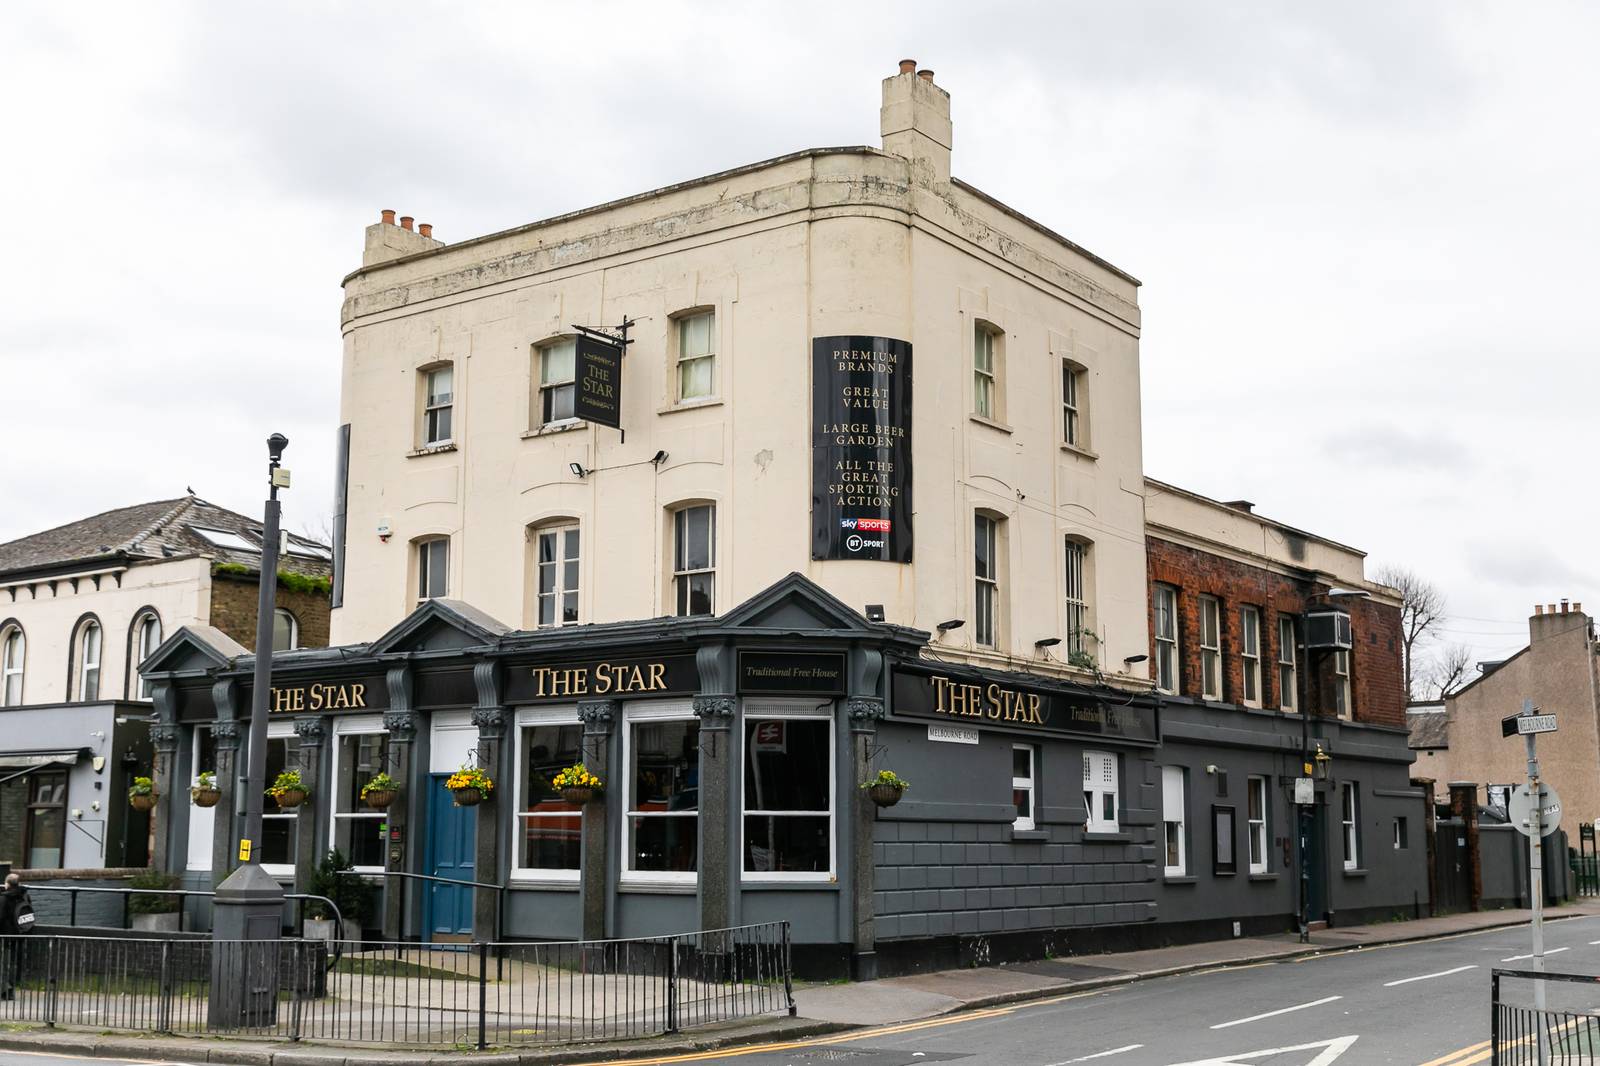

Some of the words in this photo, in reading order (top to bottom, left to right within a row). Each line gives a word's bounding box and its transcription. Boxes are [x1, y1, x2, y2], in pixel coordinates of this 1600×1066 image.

[833, 350, 897, 363] PREMIUM
[588, 364, 609, 381] THE
[839, 361, 893, 374] BRANDS
[583, 376, 613, 399] STAR
[843, 386, 889, 398] GREAT
[843, 398, 889, 410] VALUE
[823, 423, 869, 434] LARGE
[875, 424, 904, 437] BEER
[836, 435, 894, 447] GARDEN
[835, 460, 861, 470] ALL
[867, 460, 894, 472] THE
[841, 472, 888, 483] GREAT
[828, 483, 899, 497] SPORTING
[836, 495, 892, 507] ACTION
[841, 519, 857, 529] sky
[859, 519, 889, 530] sports
[849, 539, 860, 547] BT
[863, 539, 884, 548] SPORT
[746, 666, 791, 677] Traditional
[792, 667, 811, 678] Free
[812, 667, 838, 678] House
[532, 667, 588, 697] THE
[595, 663, 667, 694] STAR
[310, 683, 366, 710] STAR
[931, 675, 982, 716] THE
[987, 683, 1043, 725] STAR
[929, 727, 962, 739] MELBOURNE
[963, 730, 978, 740] ROAD
